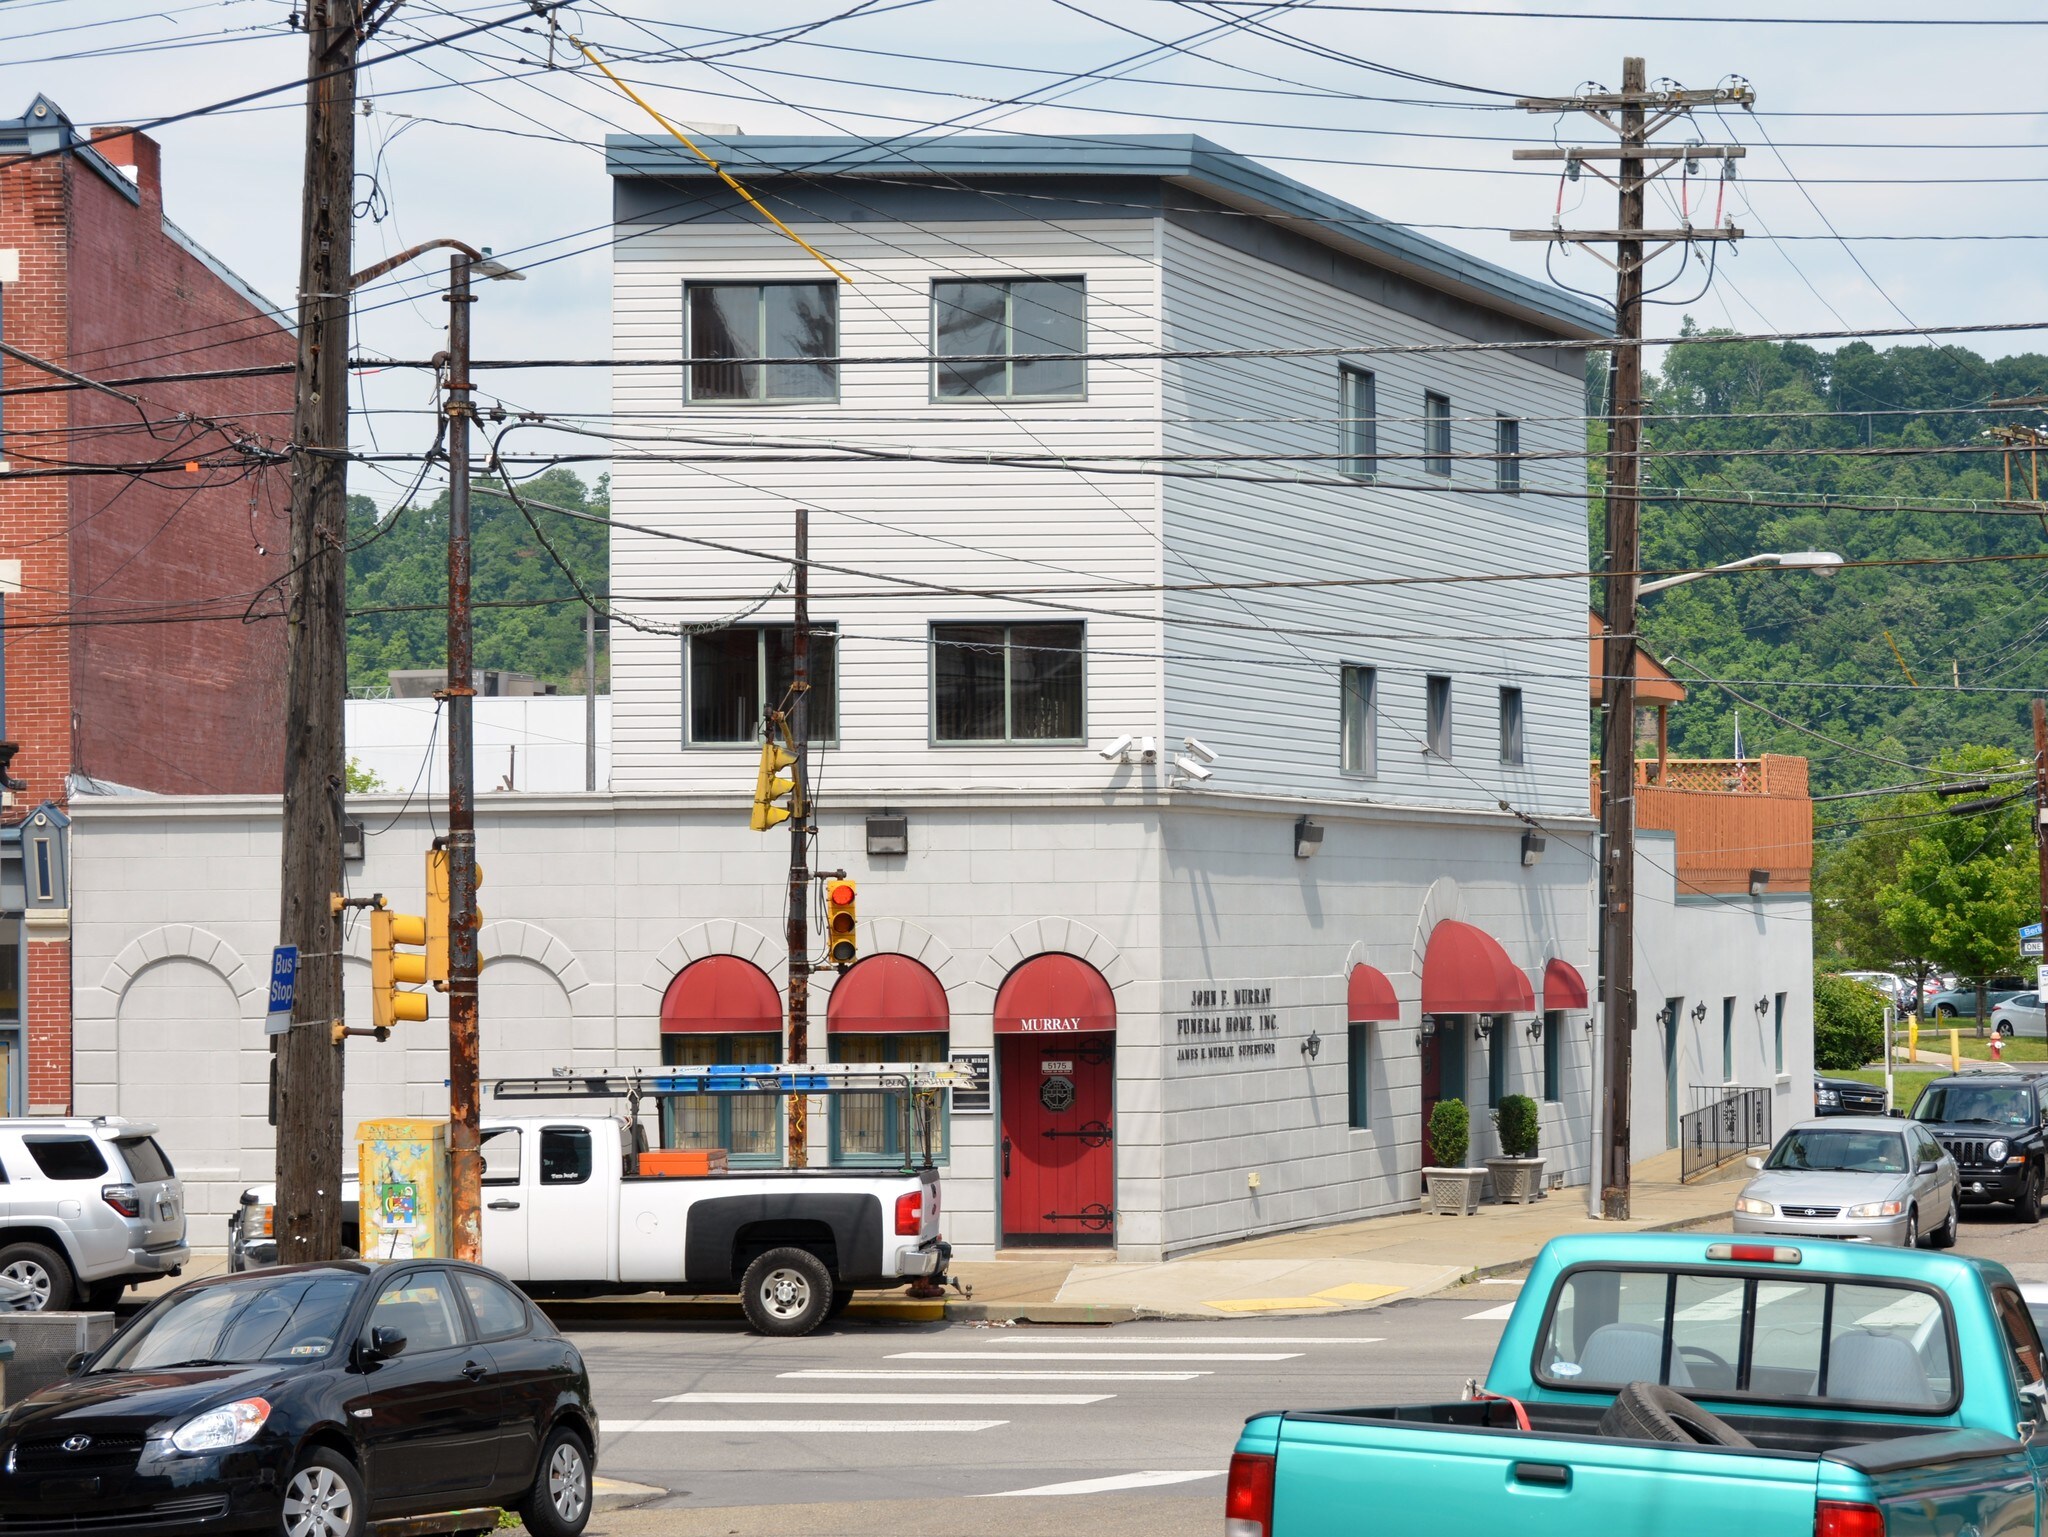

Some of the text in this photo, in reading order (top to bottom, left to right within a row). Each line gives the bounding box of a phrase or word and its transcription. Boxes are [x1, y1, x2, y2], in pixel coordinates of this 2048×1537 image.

[2026, 943, 2042, 951] ONE
[275, 953, 293, 975] Bus
[271, 980, 293, 1005] Stop
[1191, 988, 1271, 1007] JOHN F. MURRAY
[1021, 1017, 1080, 1031] MURRAY
[1177, 1014, 1280, 1035] FUNERAL HOME, INC.
[1177, 1048, 1199, 1061] JAMES
[1238, 1043, 1276, 1057] SUPERVISOR
[1047, 1062, 1067, 1070] 5175
